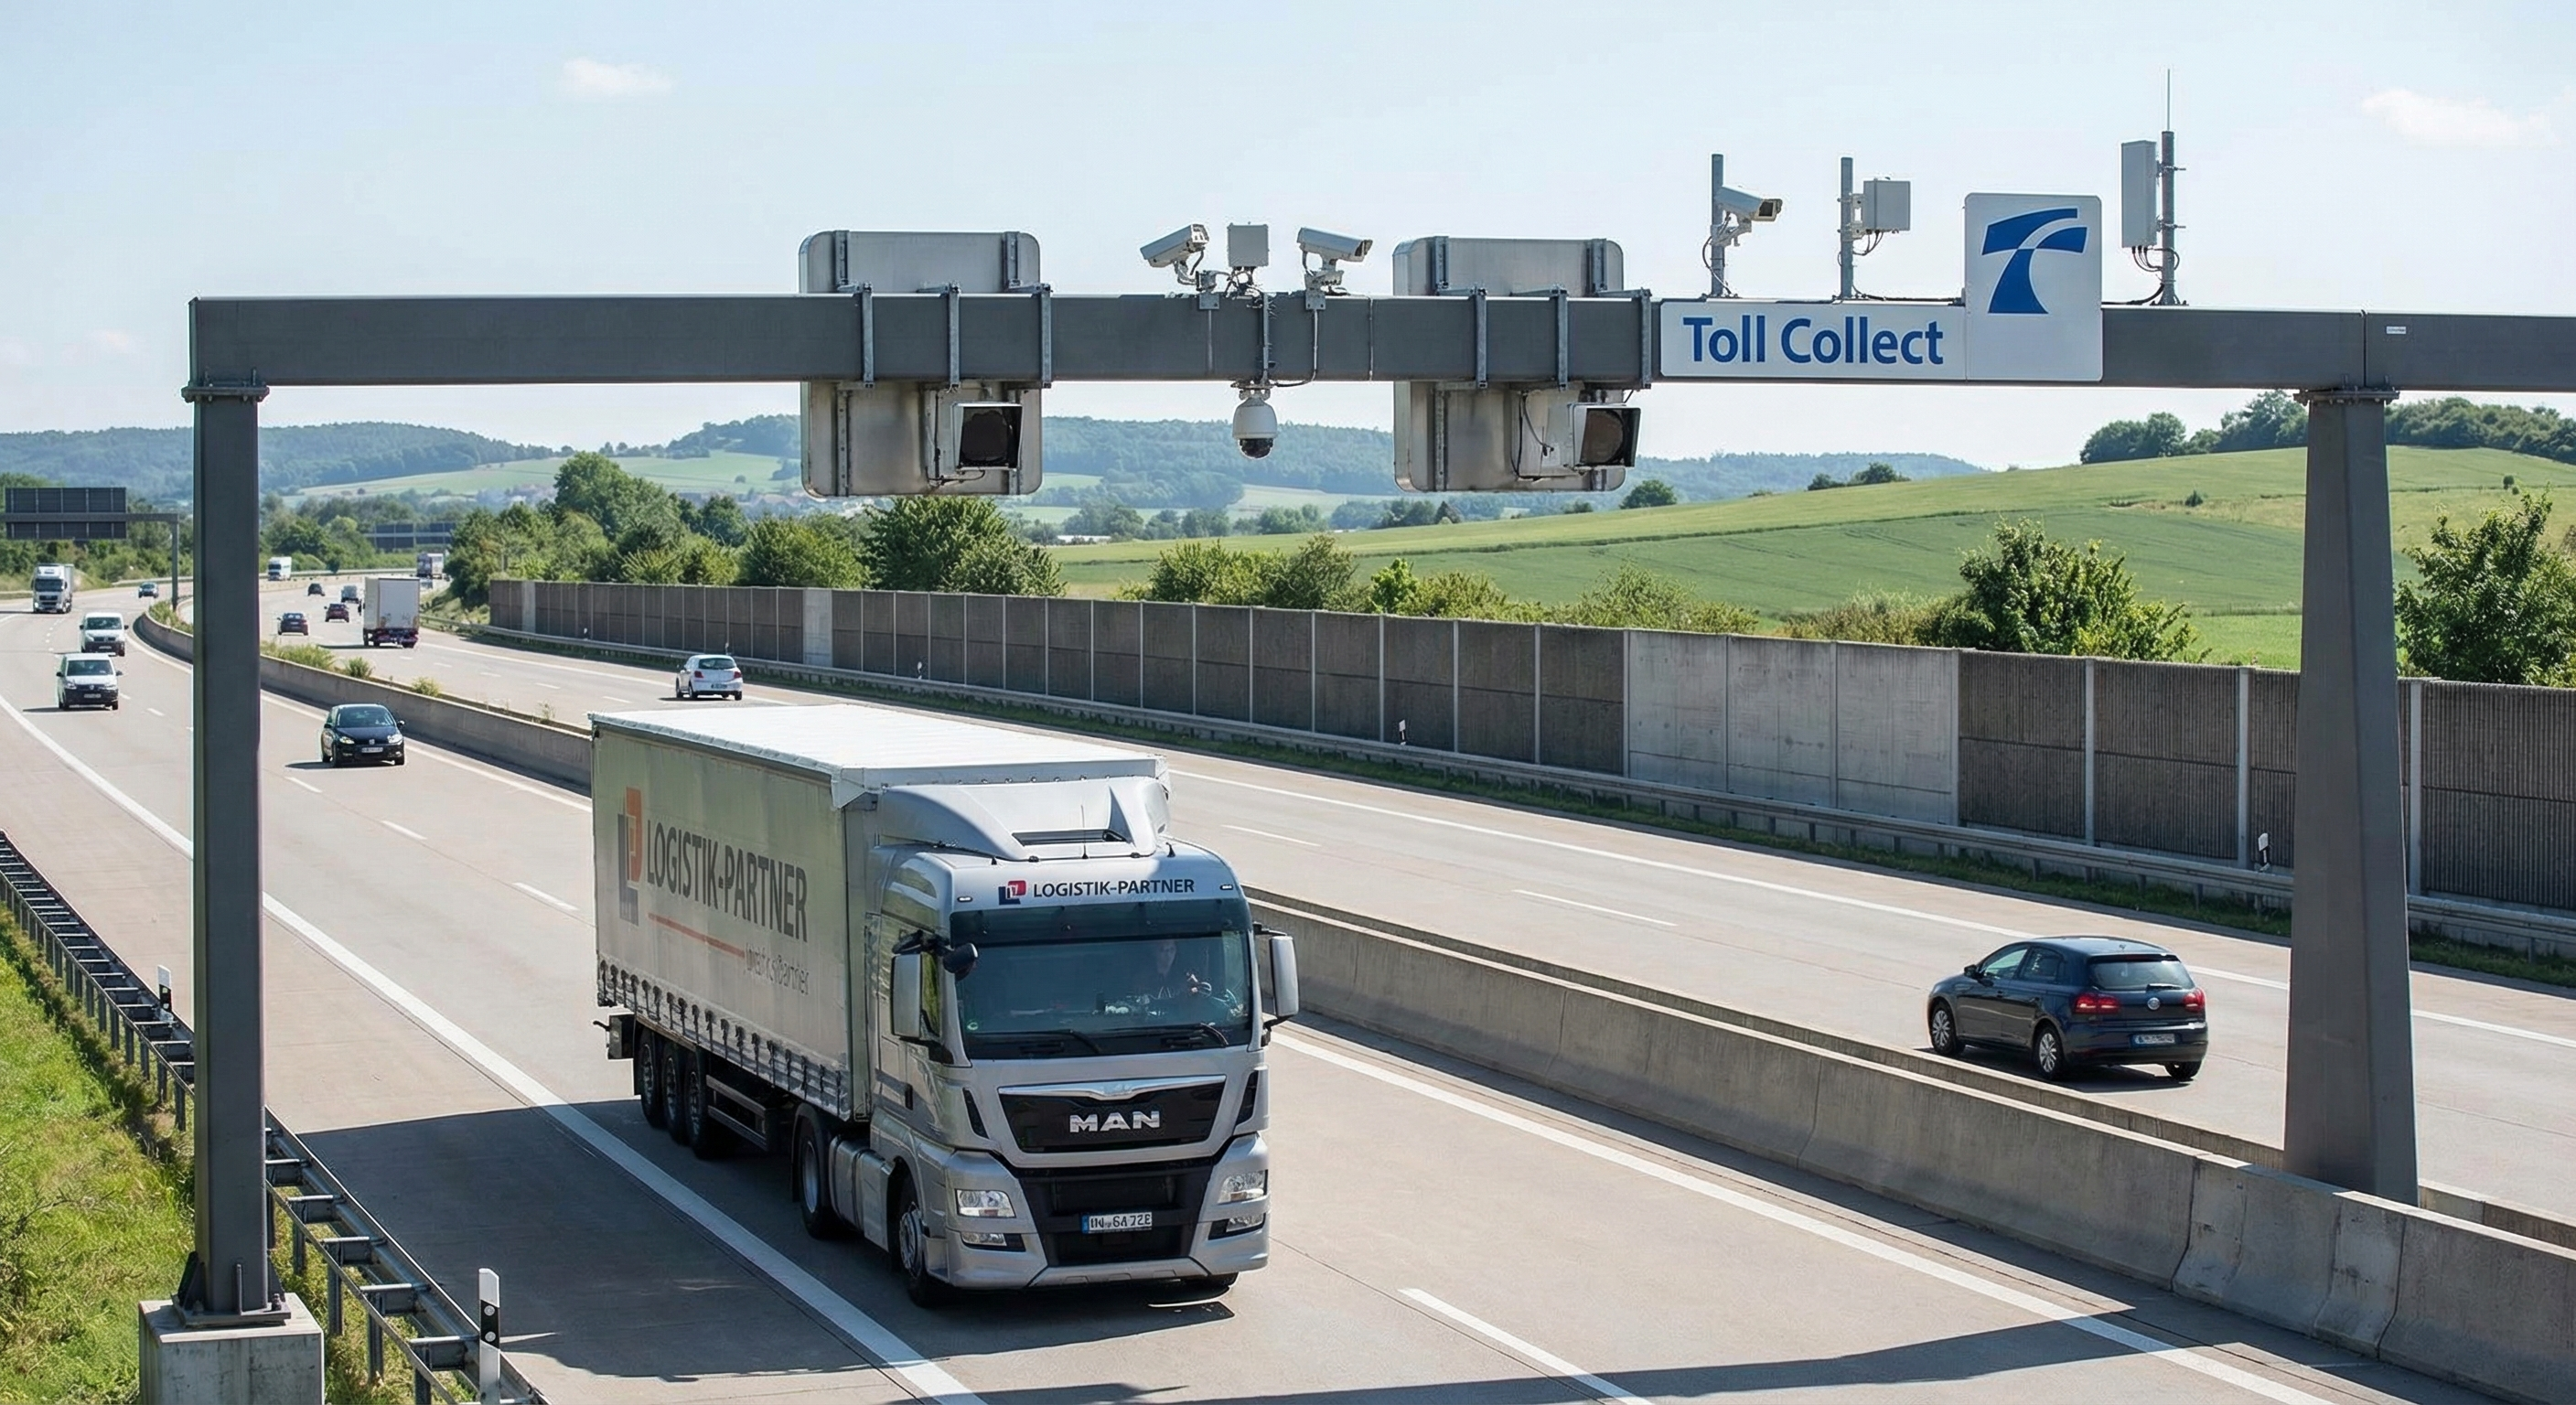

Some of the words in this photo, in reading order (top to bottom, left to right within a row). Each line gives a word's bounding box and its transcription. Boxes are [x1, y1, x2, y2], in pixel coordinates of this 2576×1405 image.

[1682, 315, 1766, 362] Toll
[1781, 316, 1944, 365] Collect
[646, 820, 808, 943] LOGISTIK-PARTNER
[1034, 878, 1195, 898] LOGISTIK-PARTNER
[1069, 1110, 1160, 1133] MAN
